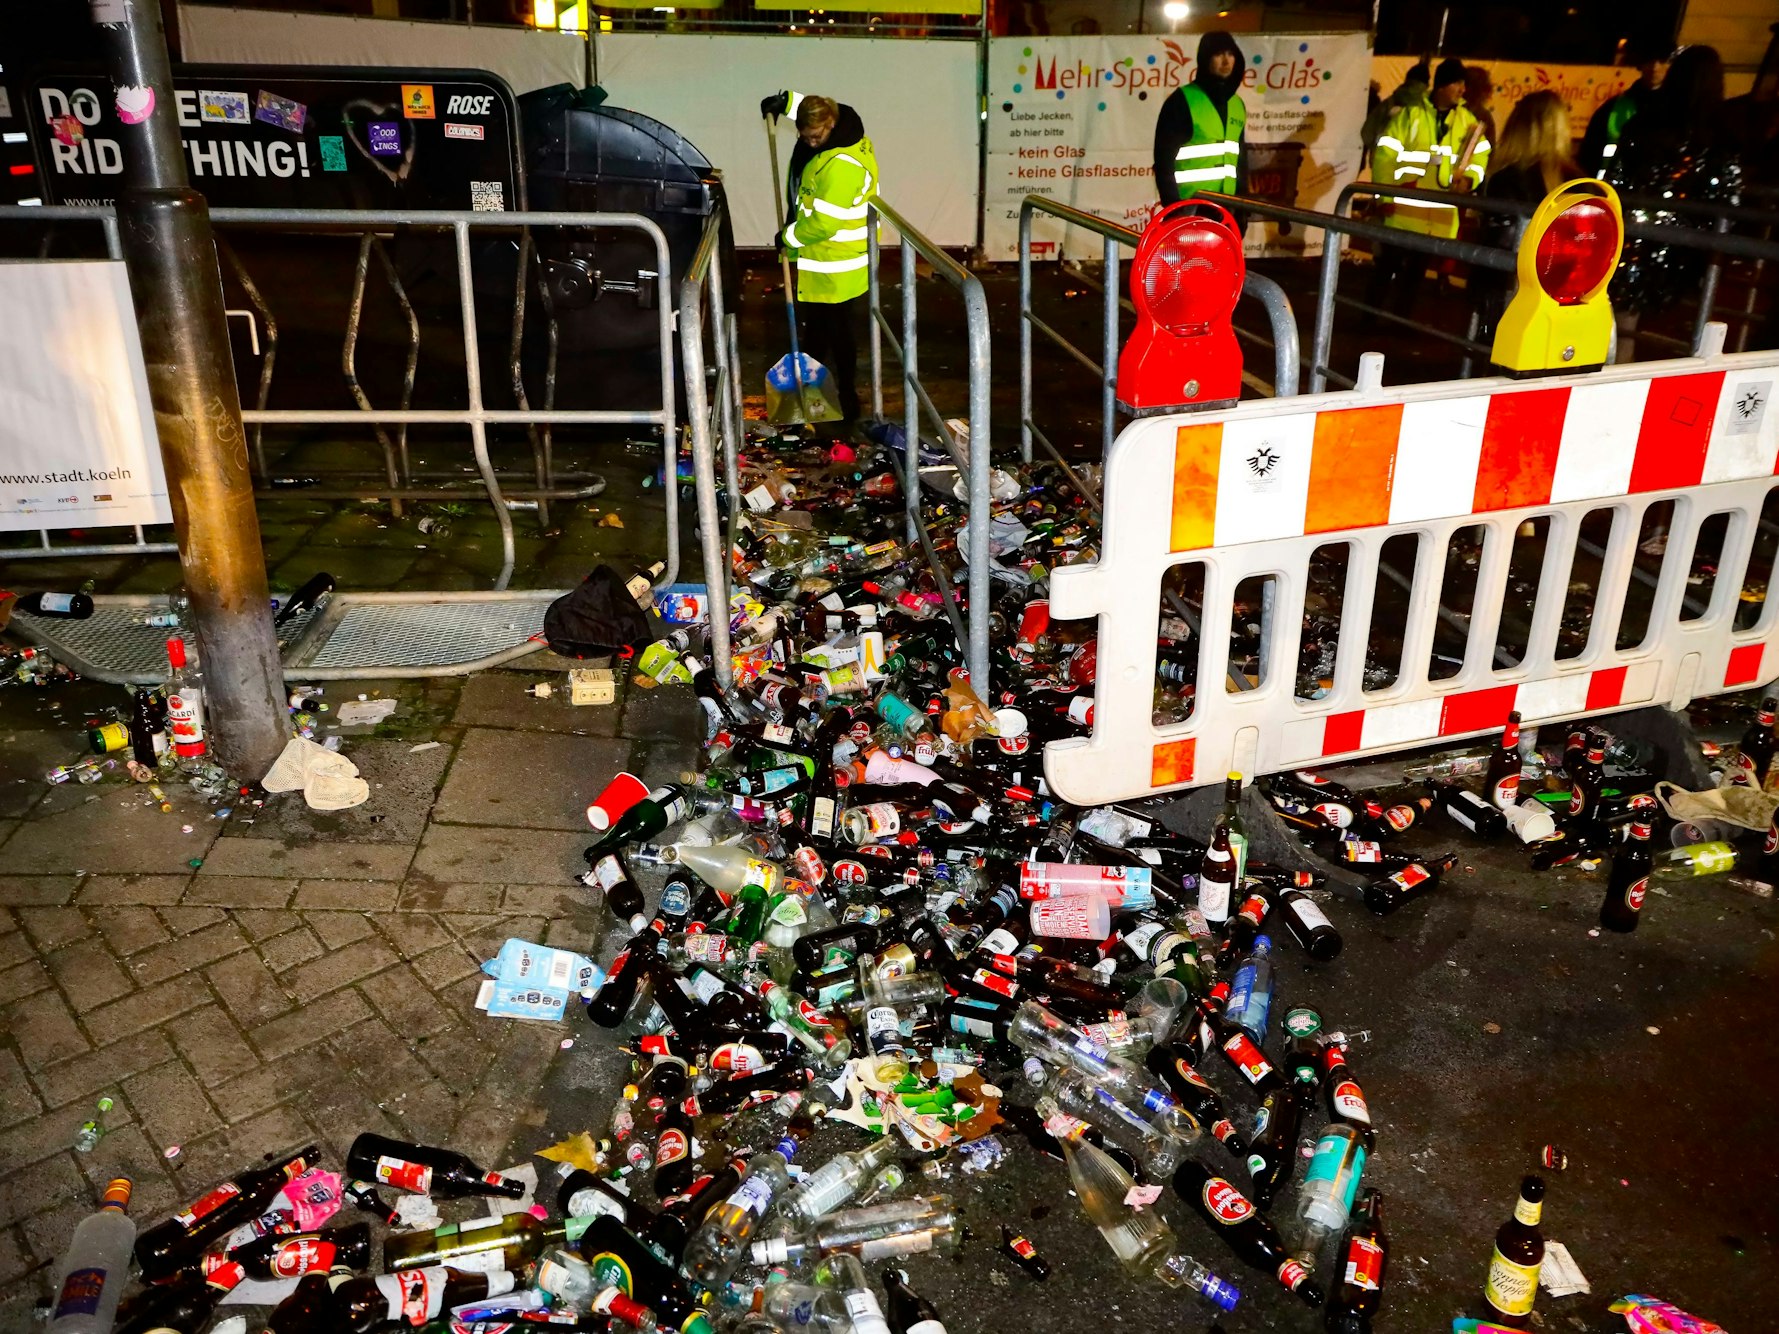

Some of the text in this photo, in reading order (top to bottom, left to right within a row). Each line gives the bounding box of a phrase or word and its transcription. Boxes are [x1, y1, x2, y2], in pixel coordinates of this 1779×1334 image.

[1035, 54, 1105, 90] Mehr
[1113, 60, 1181, 96] Spaß
[1266, 61, 1321, 89] Glas
[39, 88, 101, 126] DO
[446, 95, 494, 115] ROSE
[1010, 111, 1074, 121] Liebe Jecken,
[1263, 110, 1325, 119] Glasflaschen
[1010, 128, 1065, 137] ab hier bitte
[182, 140, 310, 178] HING!
[1018, 147, 1049, 158] kein
[1053, 145, 1086, 158] Glas
[1018, 166, 1057, 178] keine
[1061, 164, 1155, 178] Glasflaschen
[1007, 186, 1054, 195] mitführen.
[1123, 203, 1152, 219] Jeck
[0, 467, 132, 485] www.stadt.koeln
[1491, 1261, 1531, 1286] Sonnen
[1491, 1274, 1531, 1296] Hopfen
